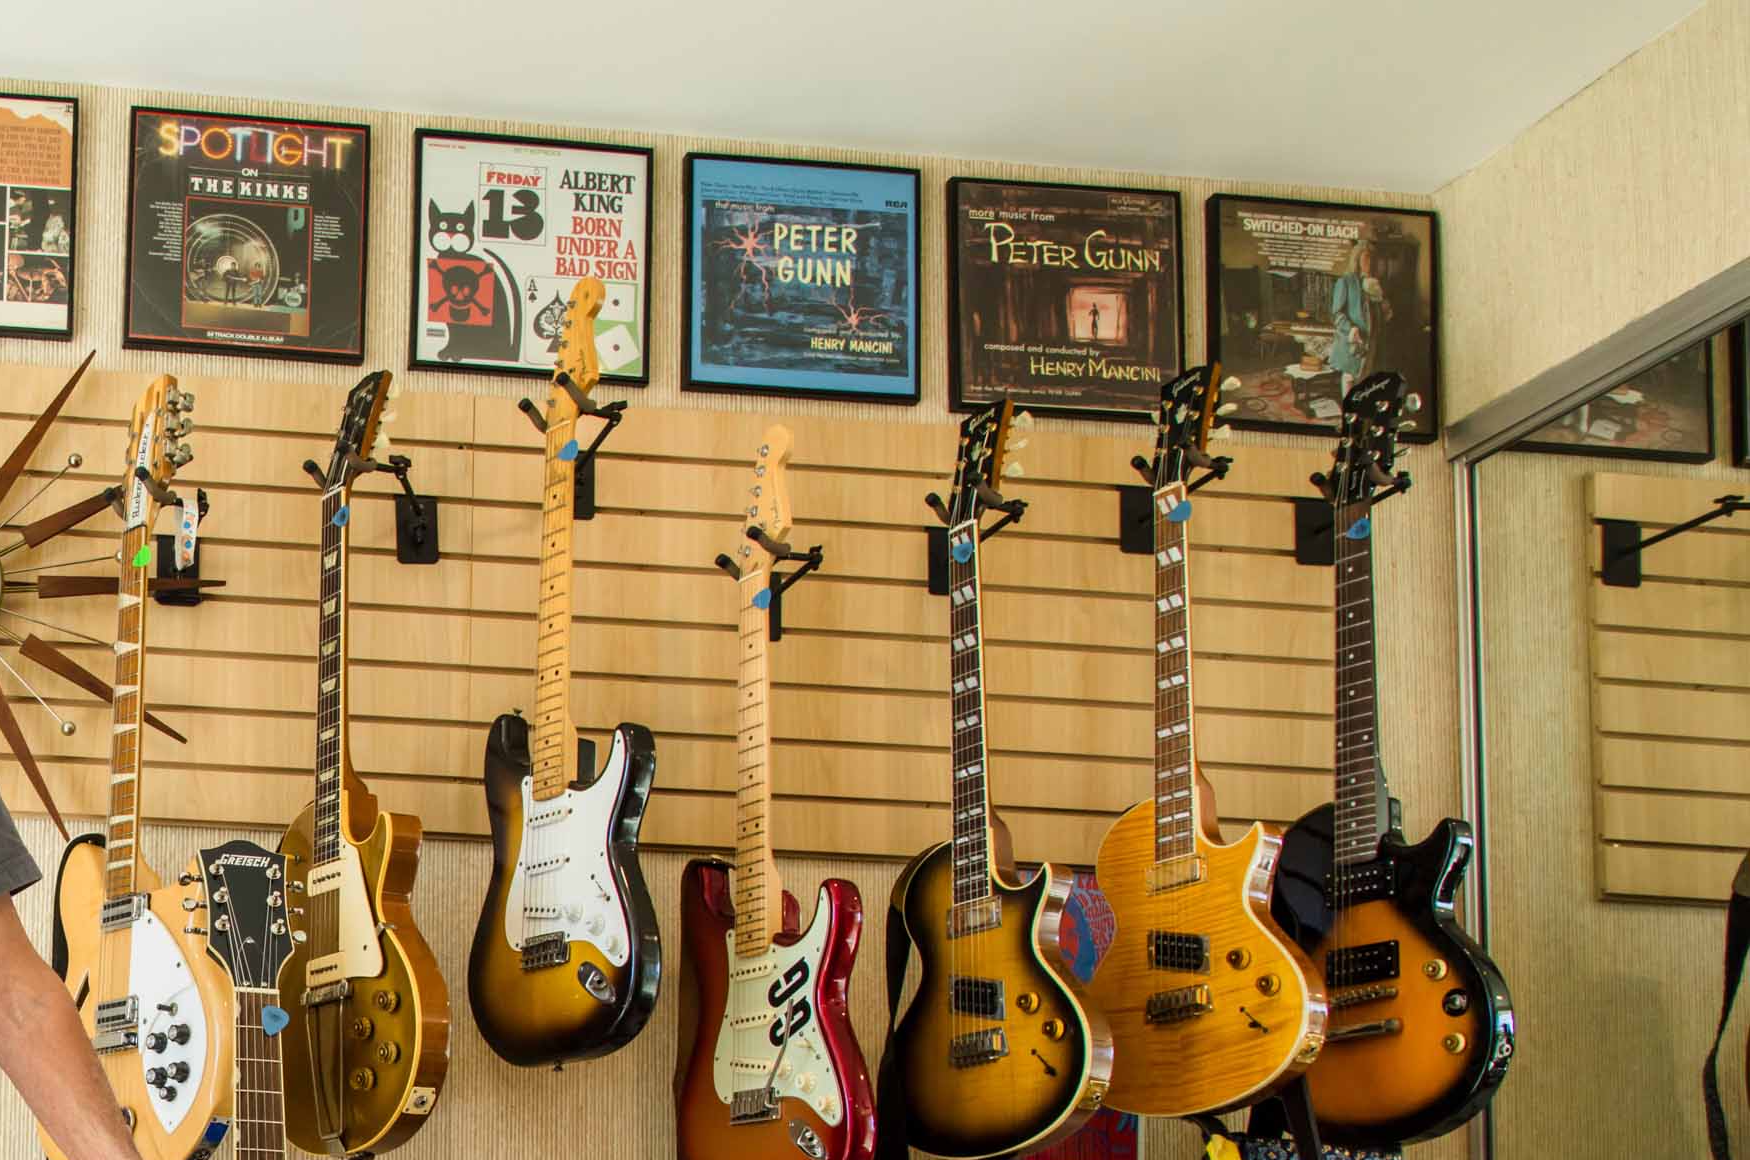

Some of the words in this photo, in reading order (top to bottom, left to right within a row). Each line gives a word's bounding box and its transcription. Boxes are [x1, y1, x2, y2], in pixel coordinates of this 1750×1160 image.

[157, 119, 354, 170] SPOTLIGHT
[241, 167, 259, 178] ON
[485, 171, 542, 187] FRIDAY
[559, 168, 636, 195] ALBERT
[190, 176, 234, 194] THE
[239, 180, 310, 201] KINKS
[482, 188, 544, 241] 13
[573, 192, 624, 214] KING
[885, 200, 908, 209] RCA
[571, 215, 623, 238] BORN
[969, 208, 995, 219] more
[999, 210, 1027, 220] music
[1030, 210, 1055, 222] from
[773, 222, 858, 254] PETER
[1242, 218, 1324, 236] SWITCHED-ON
[1326, 223, 1359, 239] BACH
[554, 235, 609, 259] UNDER
[623, 239, 638, 260] A
[984, 222, 1080, 269] PETER
[1084, 229, 1161, 272] GUNN
[554, 257, 590, 277] BAD
[593, 260, 638, 281] SIGN
[777, 255, 852, 288] GUNN
[810, 336, 846, 351] HENRY
[849, 339, 893, 354] MANCINI
[984, 343, 1025, 353] composed
[1027, 344, 1043, 353] and
[1045, 345, 1087, 356] conducted
[1089, 347, 1100, 357] by
[1030, 356, 1086, 377] HENRY
[1088, 358, 1161, 382] MANCINI
[218, 854, 271, 868] GRETSCH
